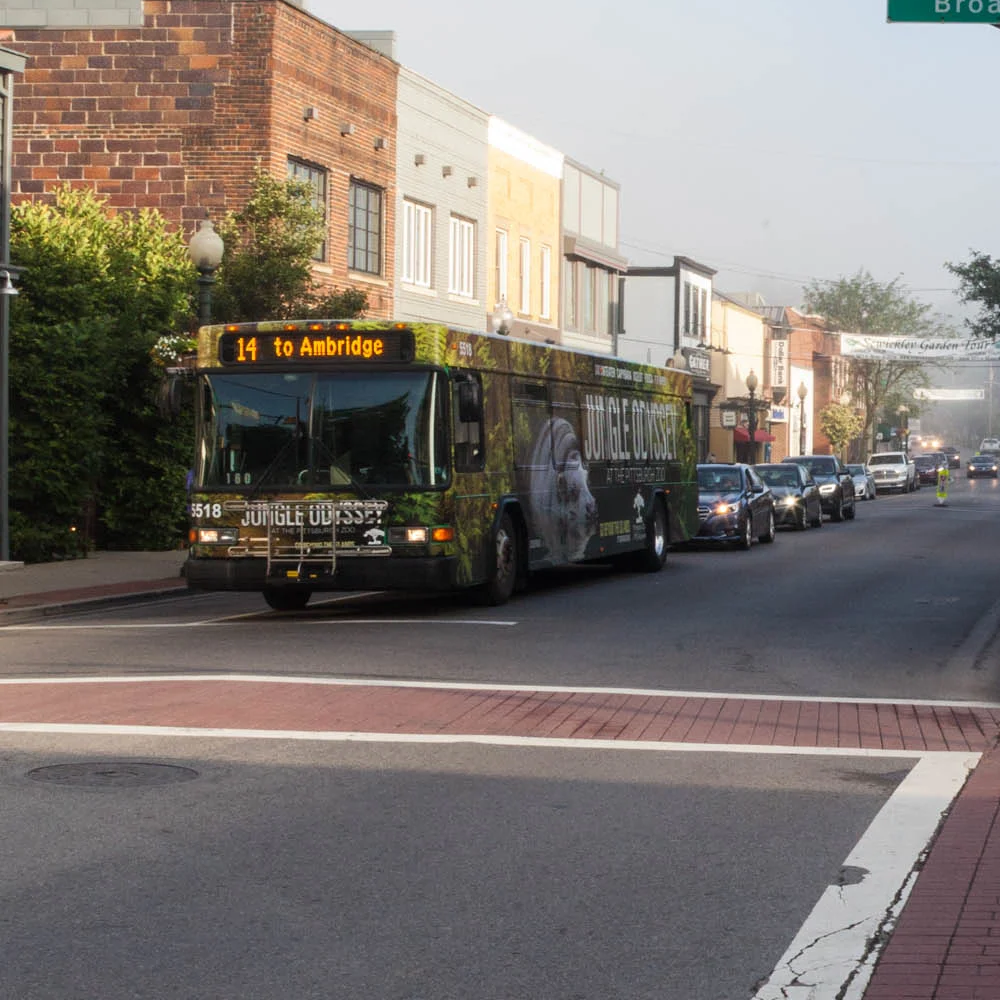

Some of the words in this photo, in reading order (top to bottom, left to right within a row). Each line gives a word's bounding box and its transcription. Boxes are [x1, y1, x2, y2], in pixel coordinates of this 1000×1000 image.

[237, 337, 257, 361] 14
[274, 336, 294, 357] to
[300, 335, 383, 358] Ambridge
[919, 338, 959, 354] Garden
[584, 394, 631, 460] JUNGLE
[241, 502, 304, 527] JUNGLE
